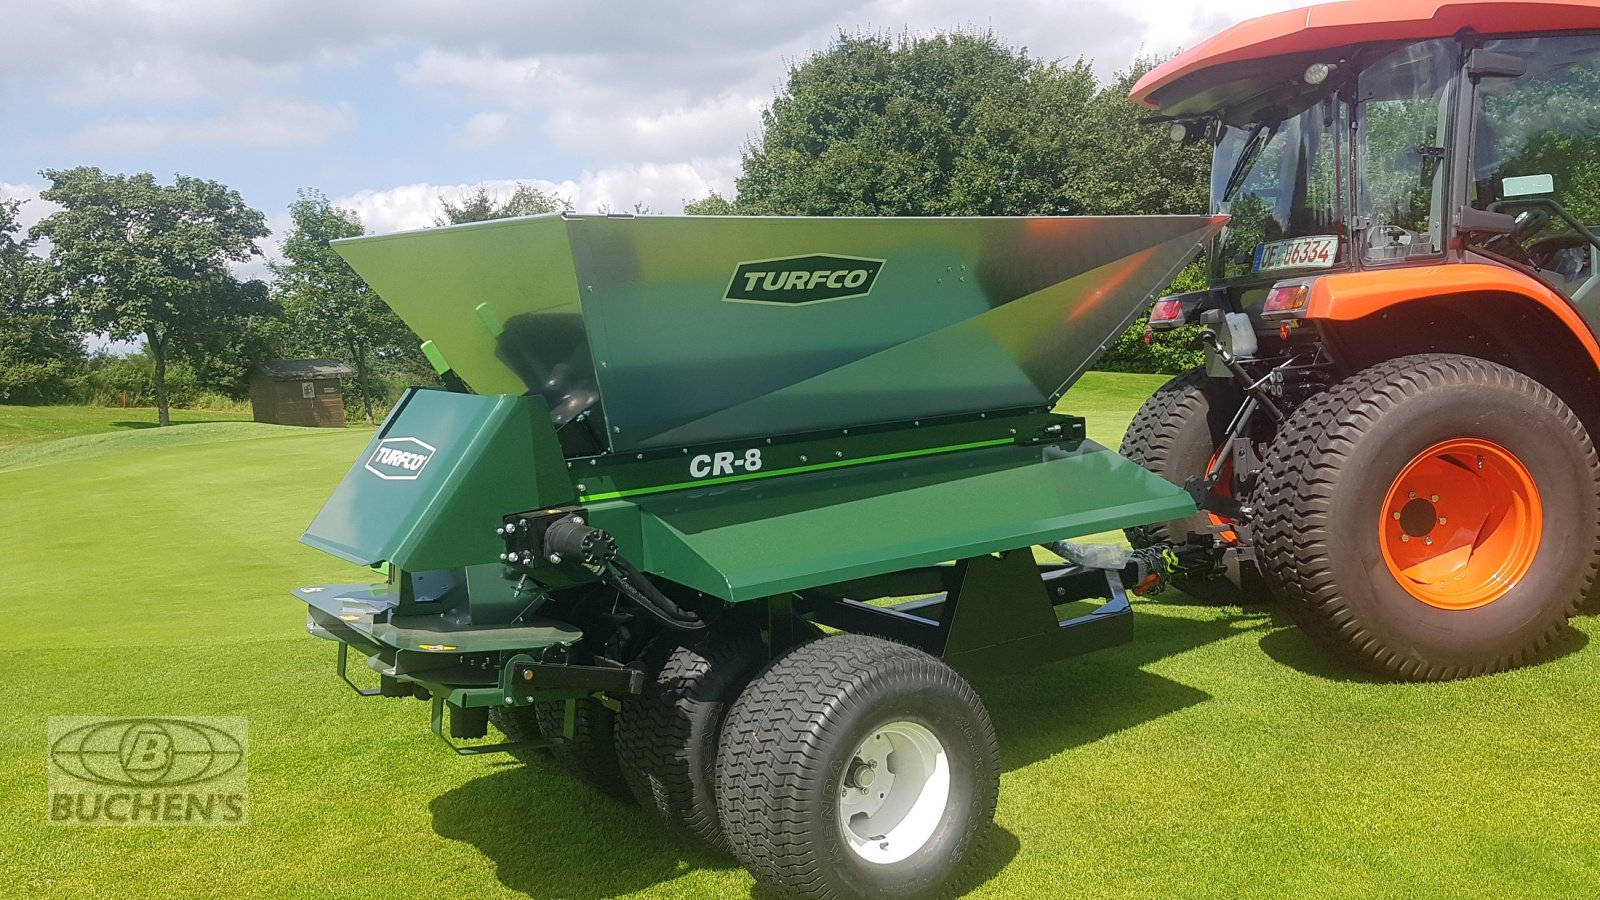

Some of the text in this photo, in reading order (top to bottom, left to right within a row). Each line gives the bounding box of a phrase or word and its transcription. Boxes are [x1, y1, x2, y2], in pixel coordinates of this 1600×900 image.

[744, 269, 868, 292] TURFCO
[375, 447, 425, 471] TURFCO
[689, 448, 762, 478] CR-8
[821, 759, 843, 864] KENDA
